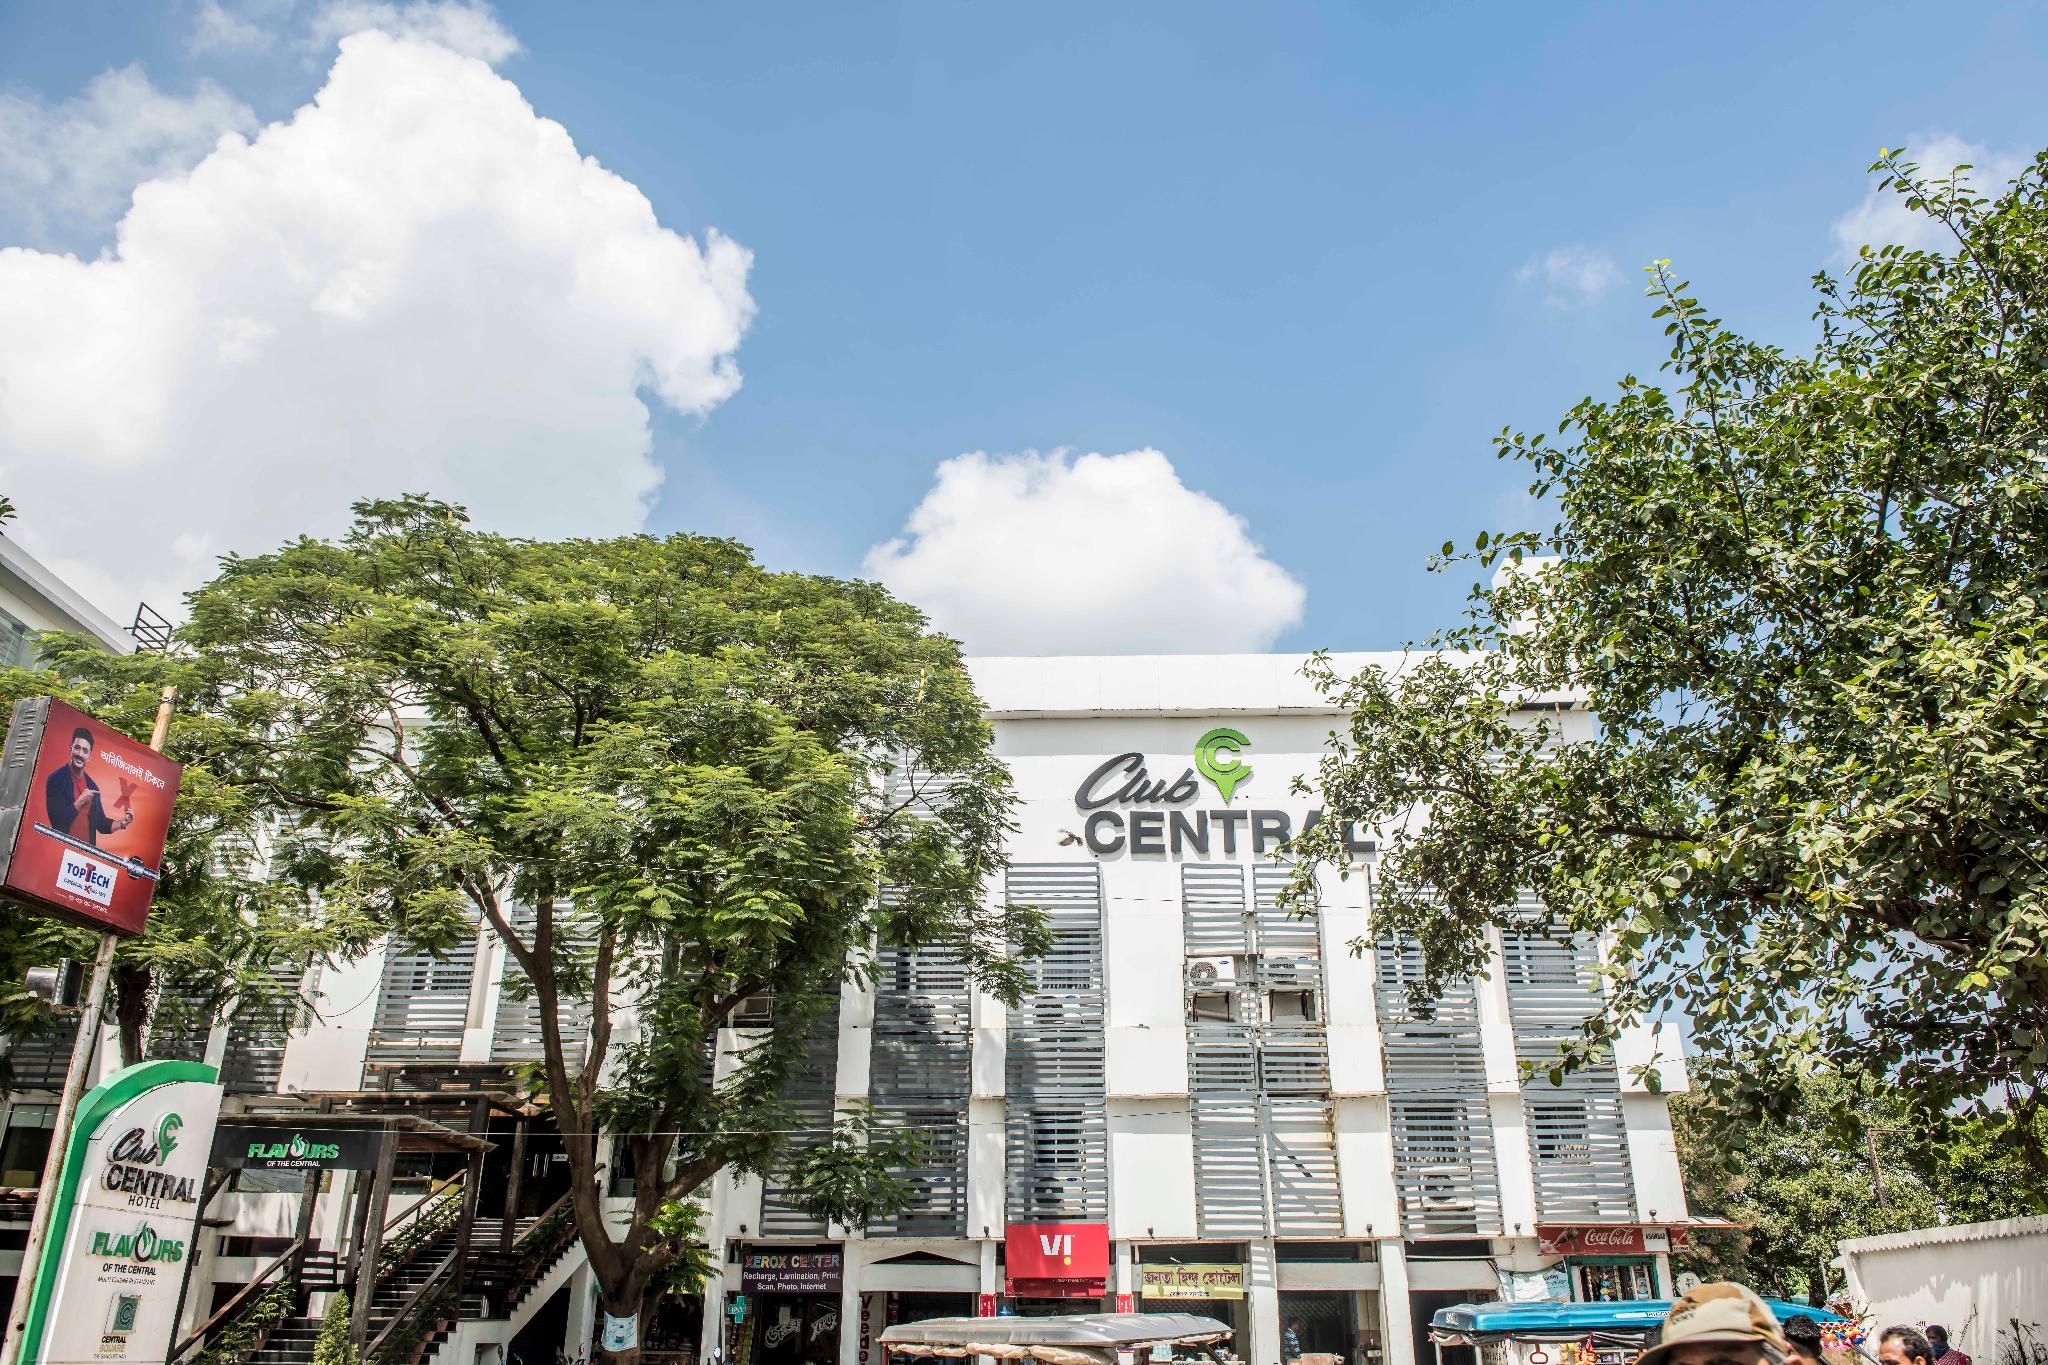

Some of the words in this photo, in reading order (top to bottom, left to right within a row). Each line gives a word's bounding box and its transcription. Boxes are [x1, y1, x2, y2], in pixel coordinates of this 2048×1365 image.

[100, 750, 144, 781] অরিজিনালই
[1074, 752, 1199, 809] Club
[67, 862, 110, 888] TOPTECH
[108, 1127, 158, 1164] Club
[247, 1135, 340, 1160] FLAVOURS
[104, 1164, 197, 1203] CENTRAL
[128, 1194, 160, 1210] HOTEL
[91, 1224, 185, 1263] FLAVOURS
[1584, 1228, 1634, 1246] Coca-Cola
[102, 1263, 113, 1273] OF
[114, 1264, 128, 1274] THE
[128, 1265, 157, 1276] CENTRAL
[745, 1255, 787, 1268] XEROX
[791, 1254, 840, 1268] CENTER
[743, 1271, 778, 1282] Recharge,
[779, 1272, 820, 1281] Lamination,
[1144, 1270, 1174, 1285] জনতা
[1203, 1268, 1241, 1286] হোটেল
[757, 1283, 776, 1291] Scan,
[777, 1283, 799, 1292] Photo,
[859, 1295, 873, 1365] Veedo
[99, 1344, 126, 1353] SQUARE
[101, 1335, 127, 1344] CENTRAL
